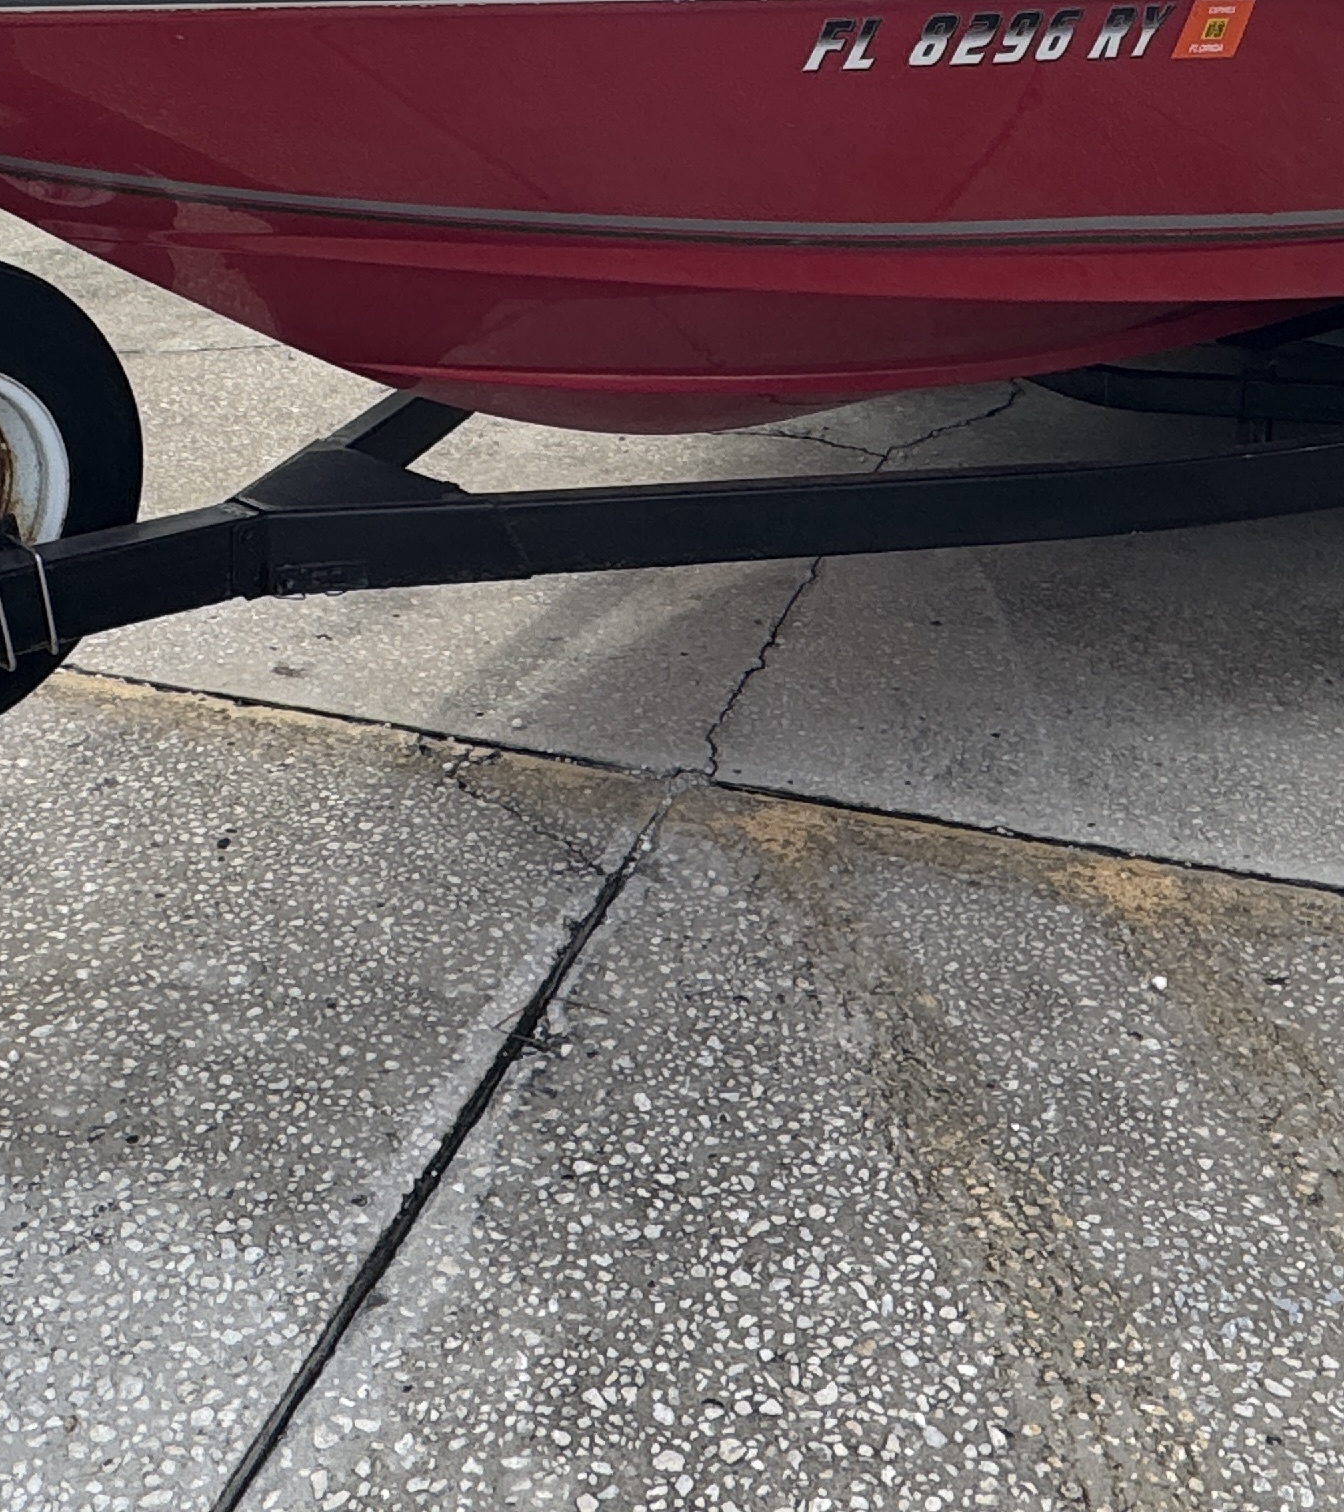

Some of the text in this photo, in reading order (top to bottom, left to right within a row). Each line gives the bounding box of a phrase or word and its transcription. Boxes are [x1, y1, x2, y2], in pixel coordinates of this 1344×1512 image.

[802, 1, 1177, 72] FL 8296 RY
